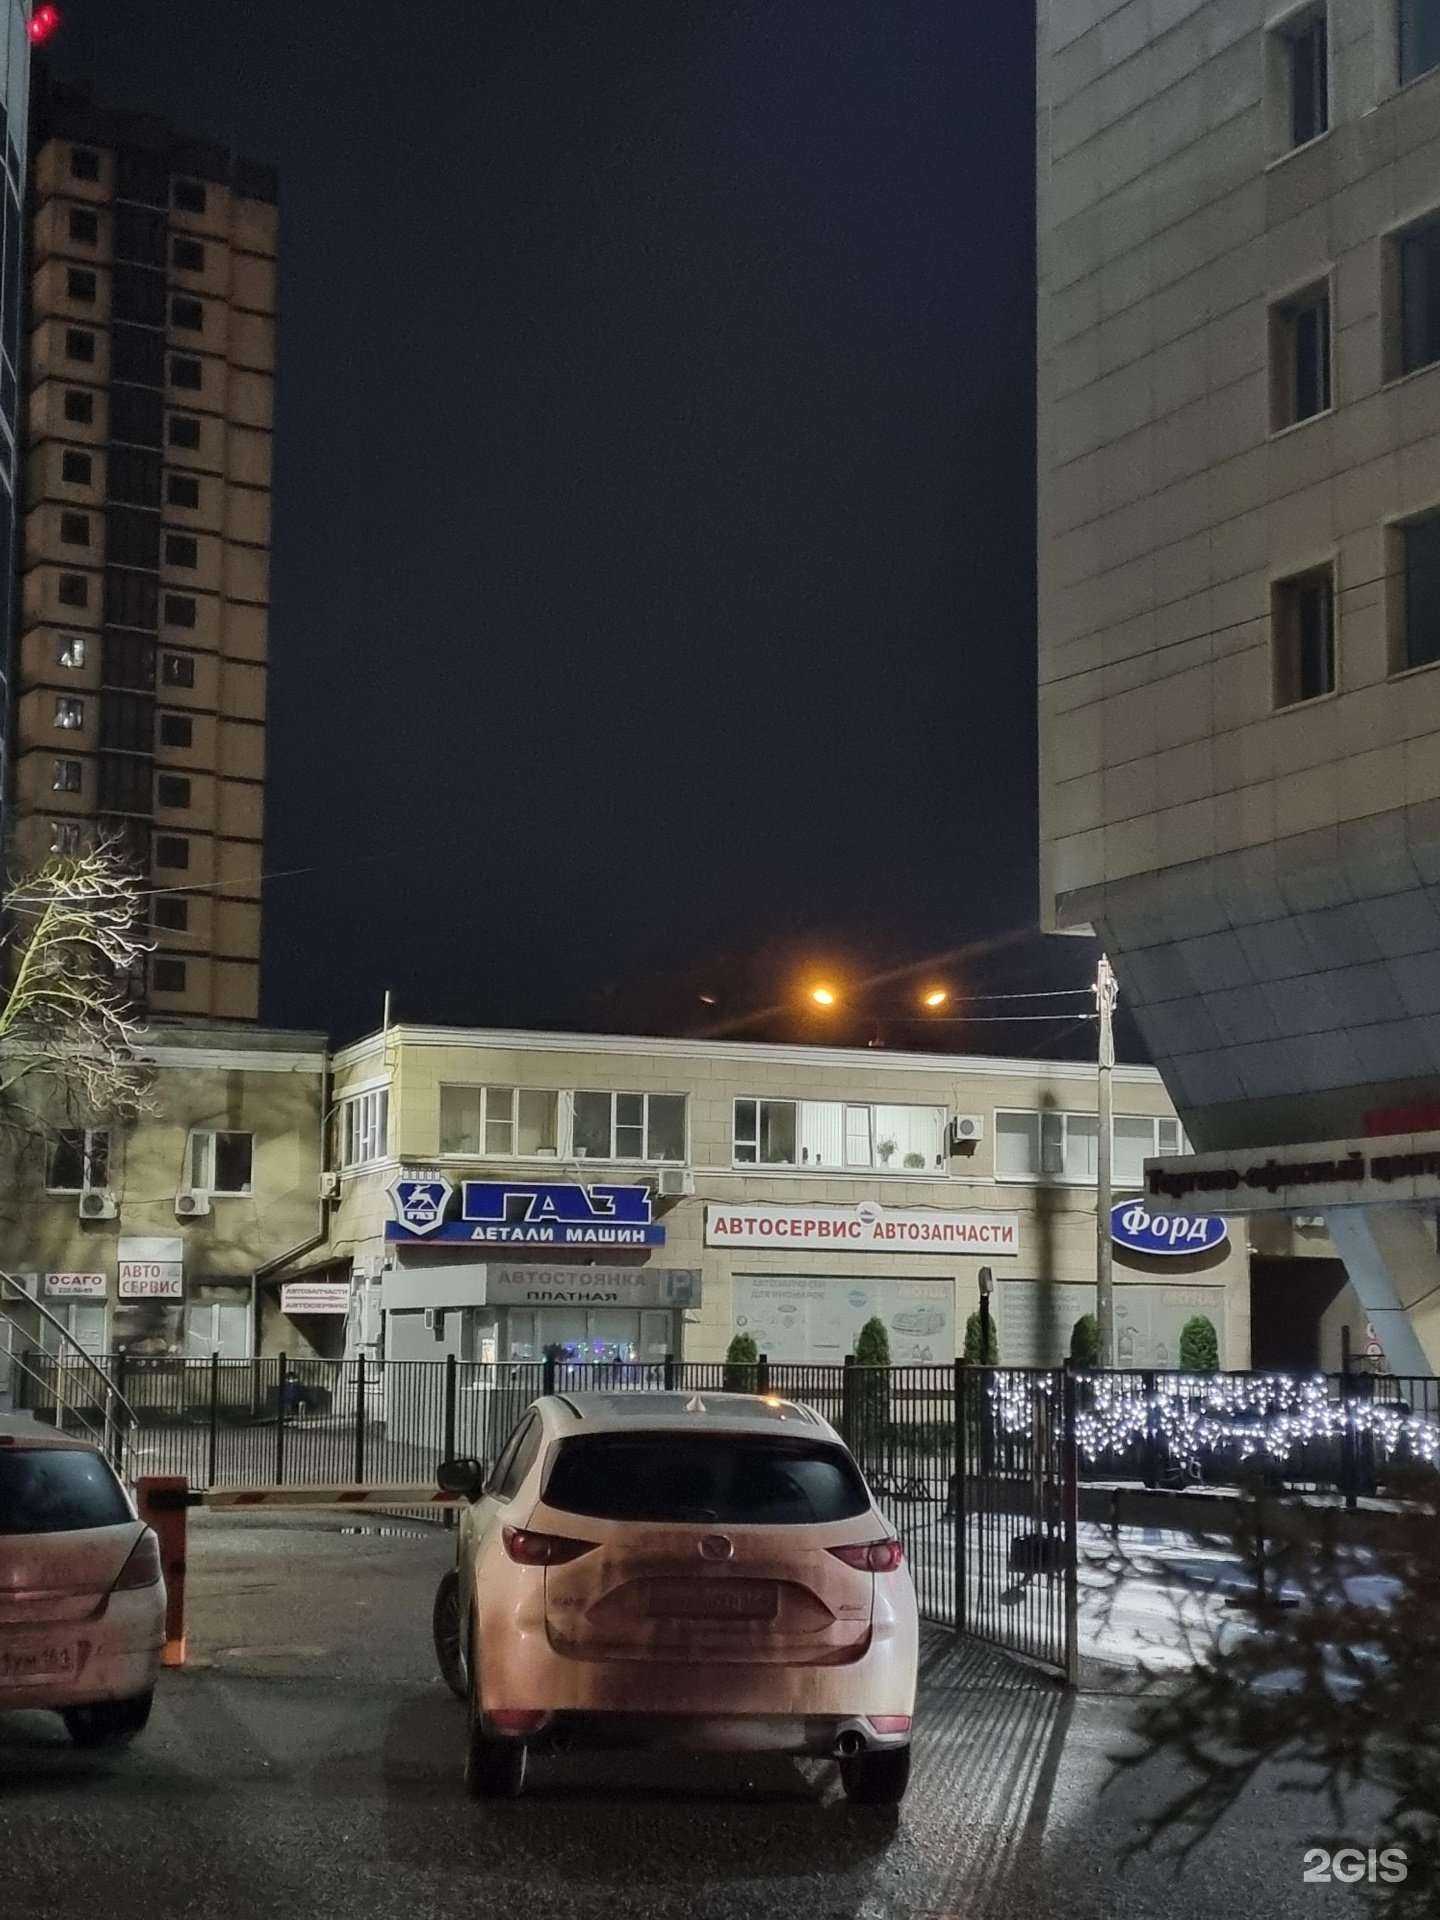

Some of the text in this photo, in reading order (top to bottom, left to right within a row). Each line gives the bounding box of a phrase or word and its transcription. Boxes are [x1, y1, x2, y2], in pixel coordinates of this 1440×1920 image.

[461, 1181, 652, 1225] ГАЗ
[713, 1217, 1014, 1243] АВТОСЕРВИС АВТОЗАПЧАСТИ
[1121, 1206, 1210, 1245] Форд
[470, 1226, 646, 1243] ДЕТАЛИ МАШИН
[122, 1264, 161, 1278] АВТО
[498, 1271, 647, 1286] АВТОСТОЯНКА
[49, 1275, 103, 1286] ОСАГО
[122, 1280, 179, 1294] СЕРВИС
[527, 1291, 618, 1302] ПЛАТНАЯ
